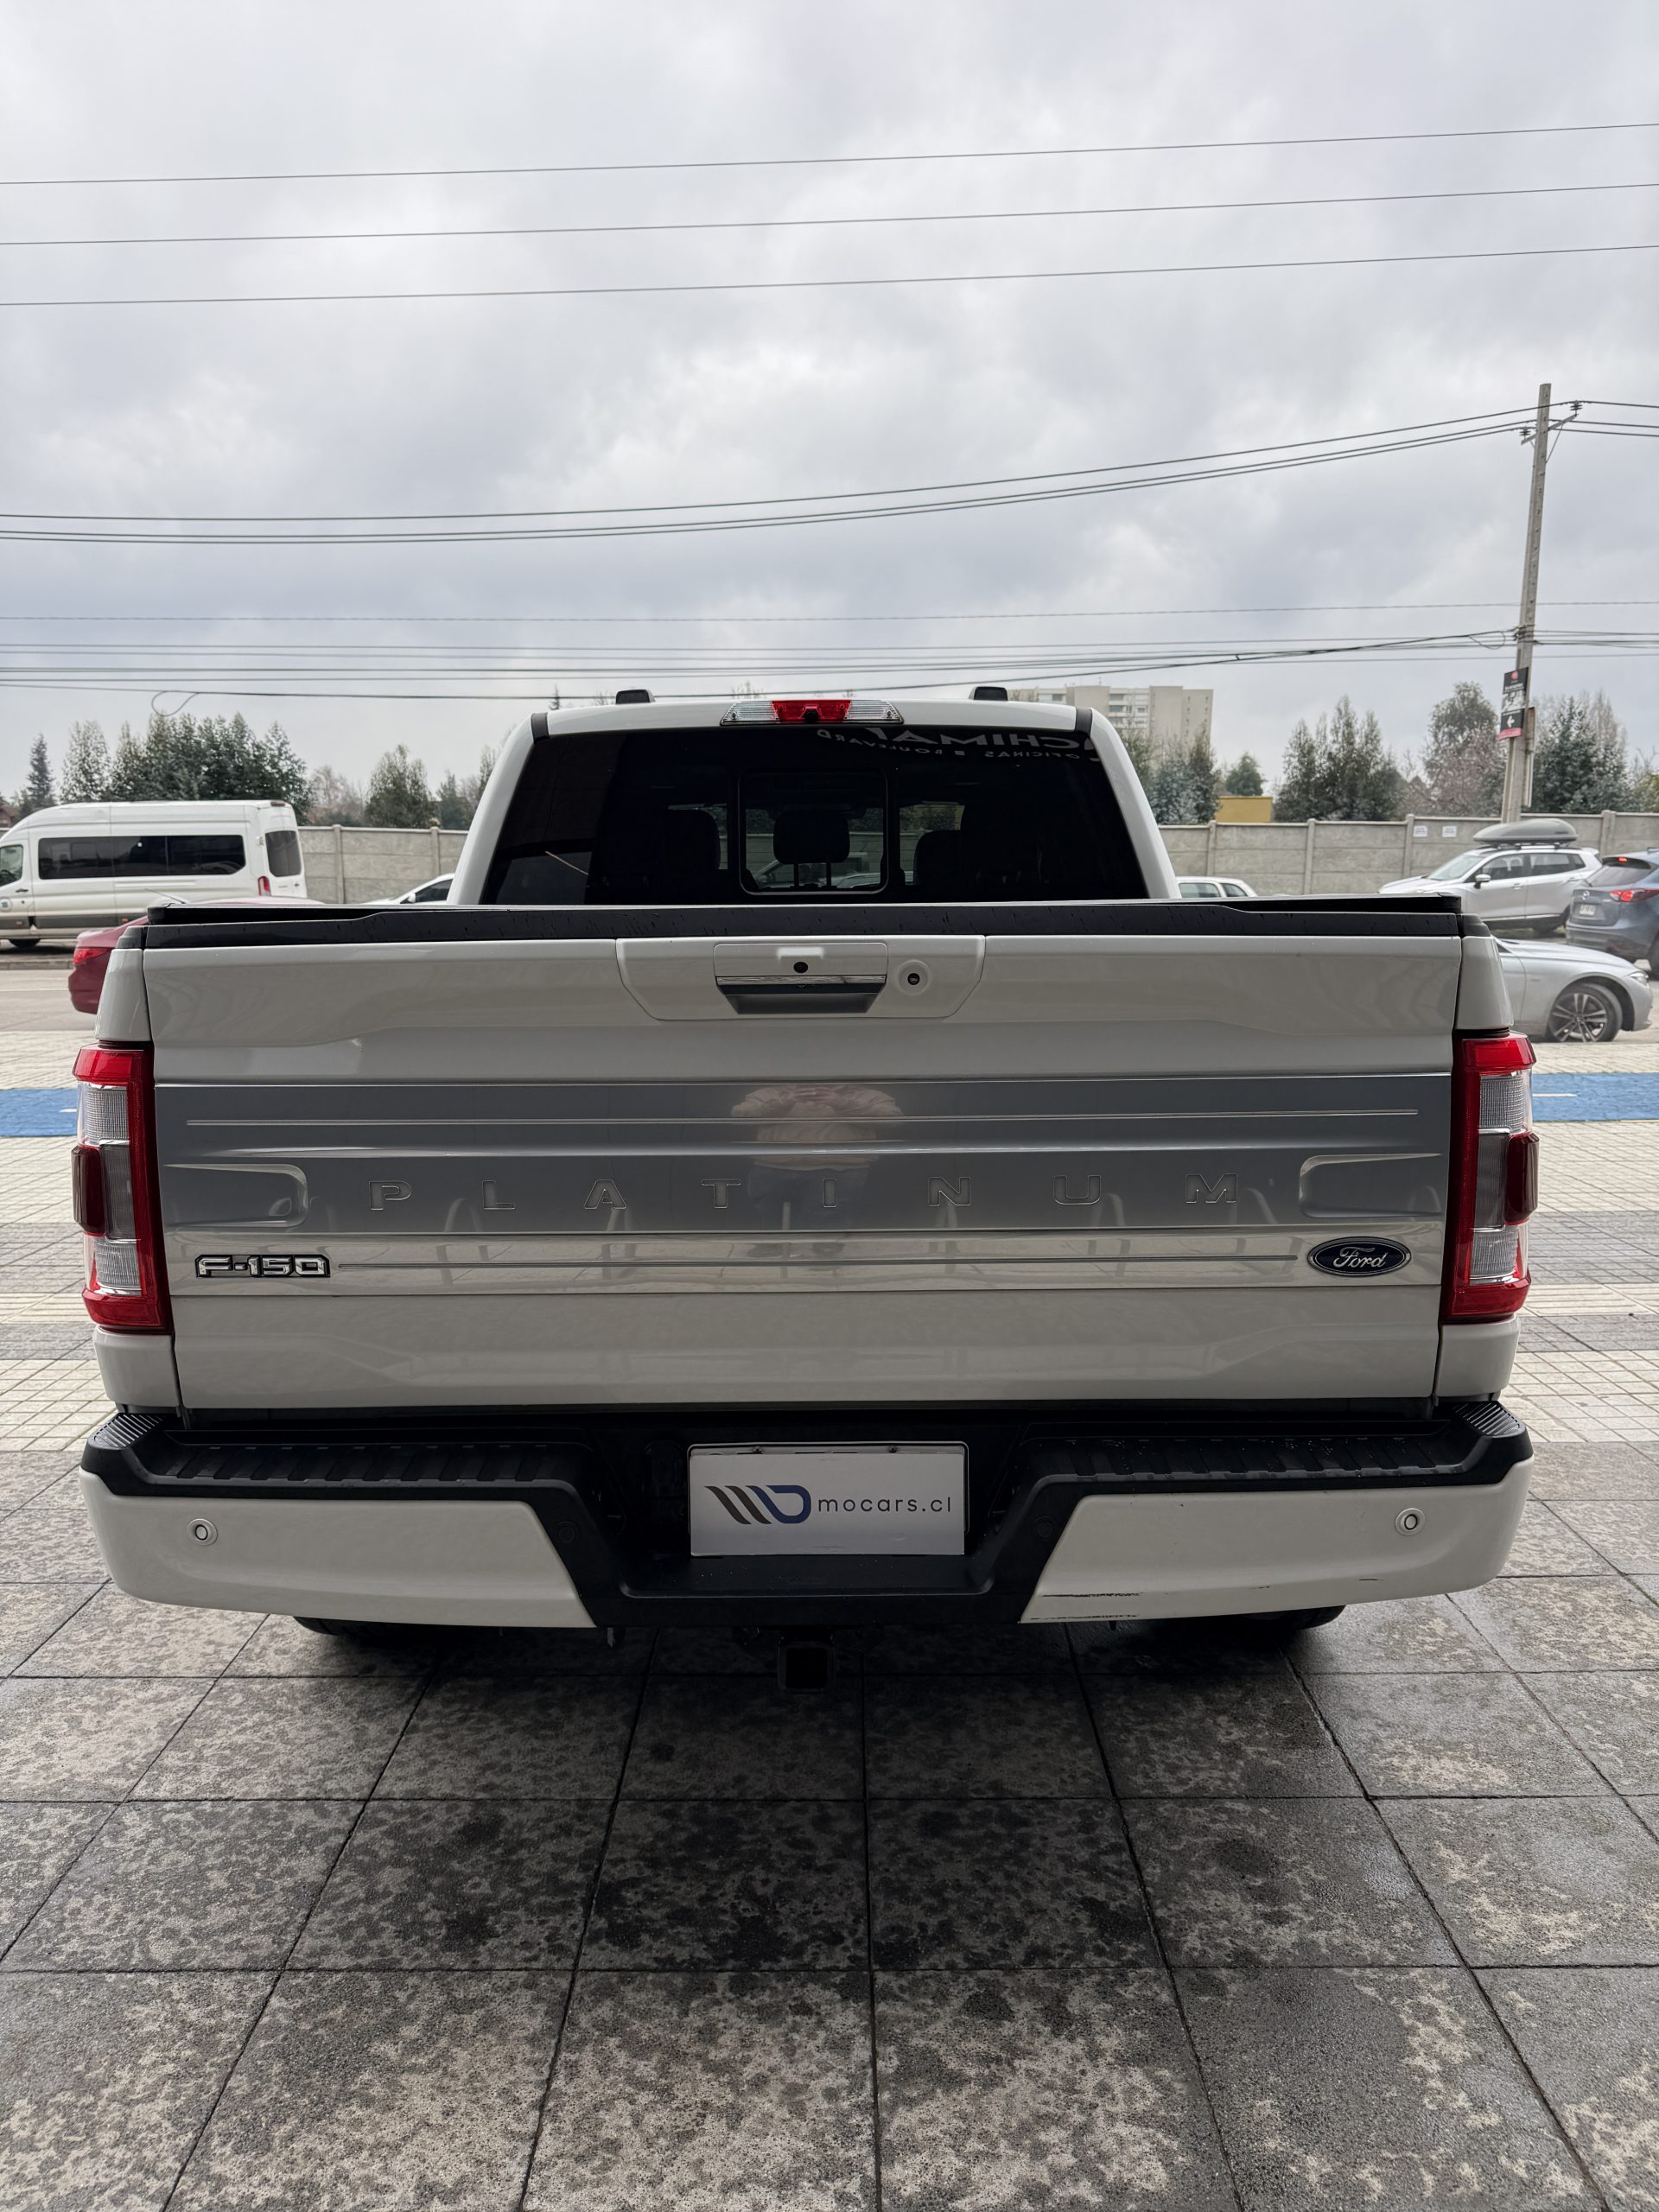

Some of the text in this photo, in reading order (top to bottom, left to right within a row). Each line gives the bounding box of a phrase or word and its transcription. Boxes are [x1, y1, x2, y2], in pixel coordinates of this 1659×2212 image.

[368, 1173, 1238, 1211] PLATINUM
[195, 1255, 331, 1277] F-150
[1332, 1246, 1389, 1268] Ford
[817, 1496, 951, 1513] mocars.cl
